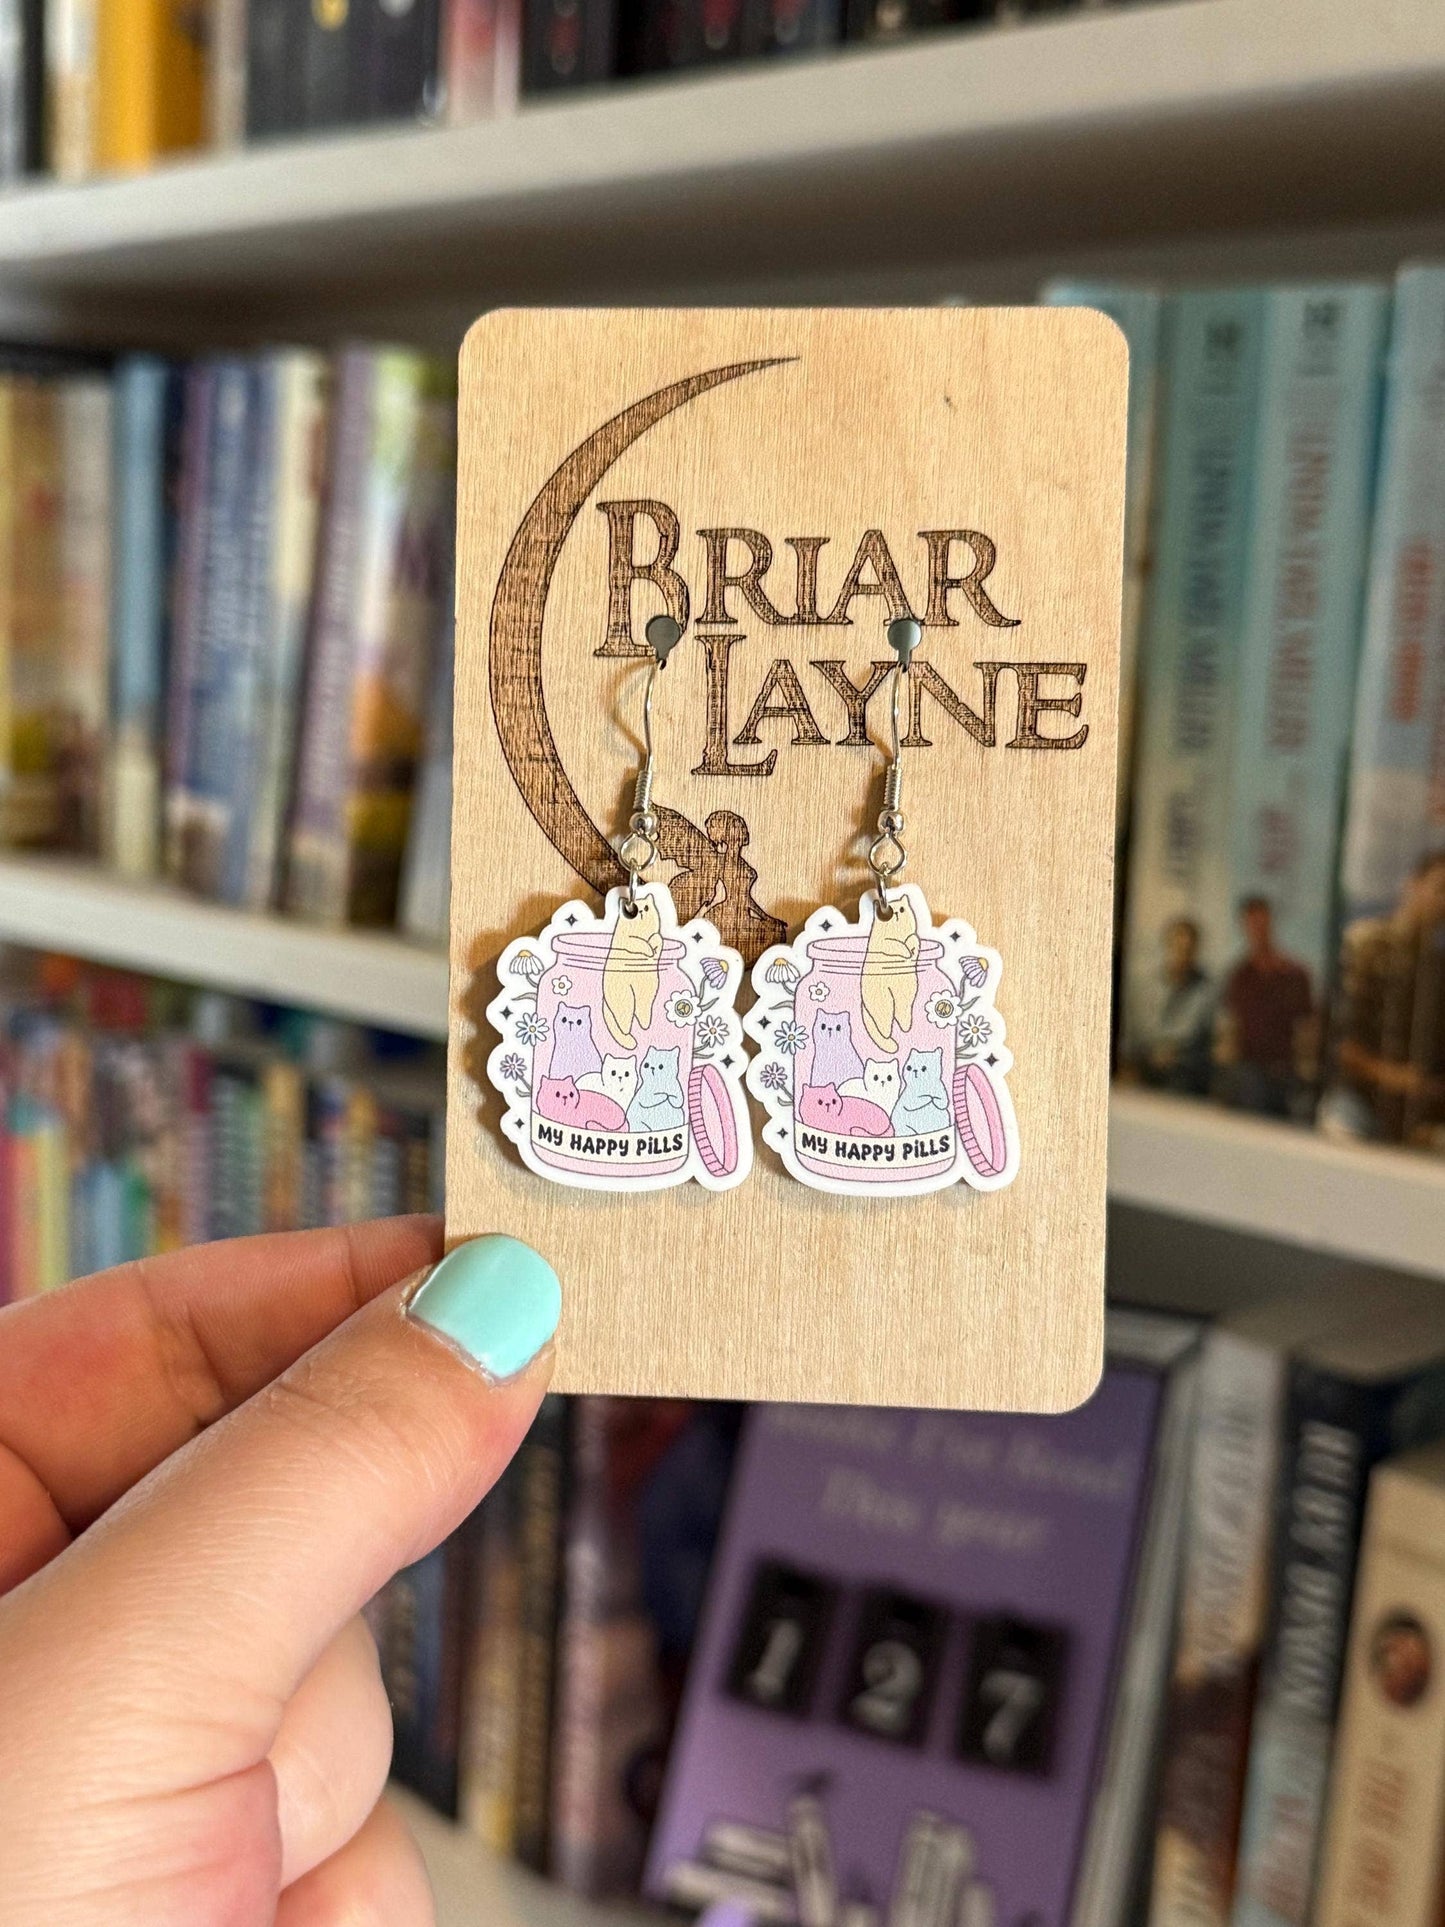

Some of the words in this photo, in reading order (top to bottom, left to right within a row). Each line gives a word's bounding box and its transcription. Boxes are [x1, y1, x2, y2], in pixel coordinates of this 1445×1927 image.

[596, 499, 1021, 656] BRIAR
[691, 634, 1088, 776] LAYNE
[538, 1123, 564, 1146] MY
[570, 1132, 629, 1157] HAPPY
[801, 1132, 828, 1153] MY
[835, 1142, 895, 1162] HAPPY
